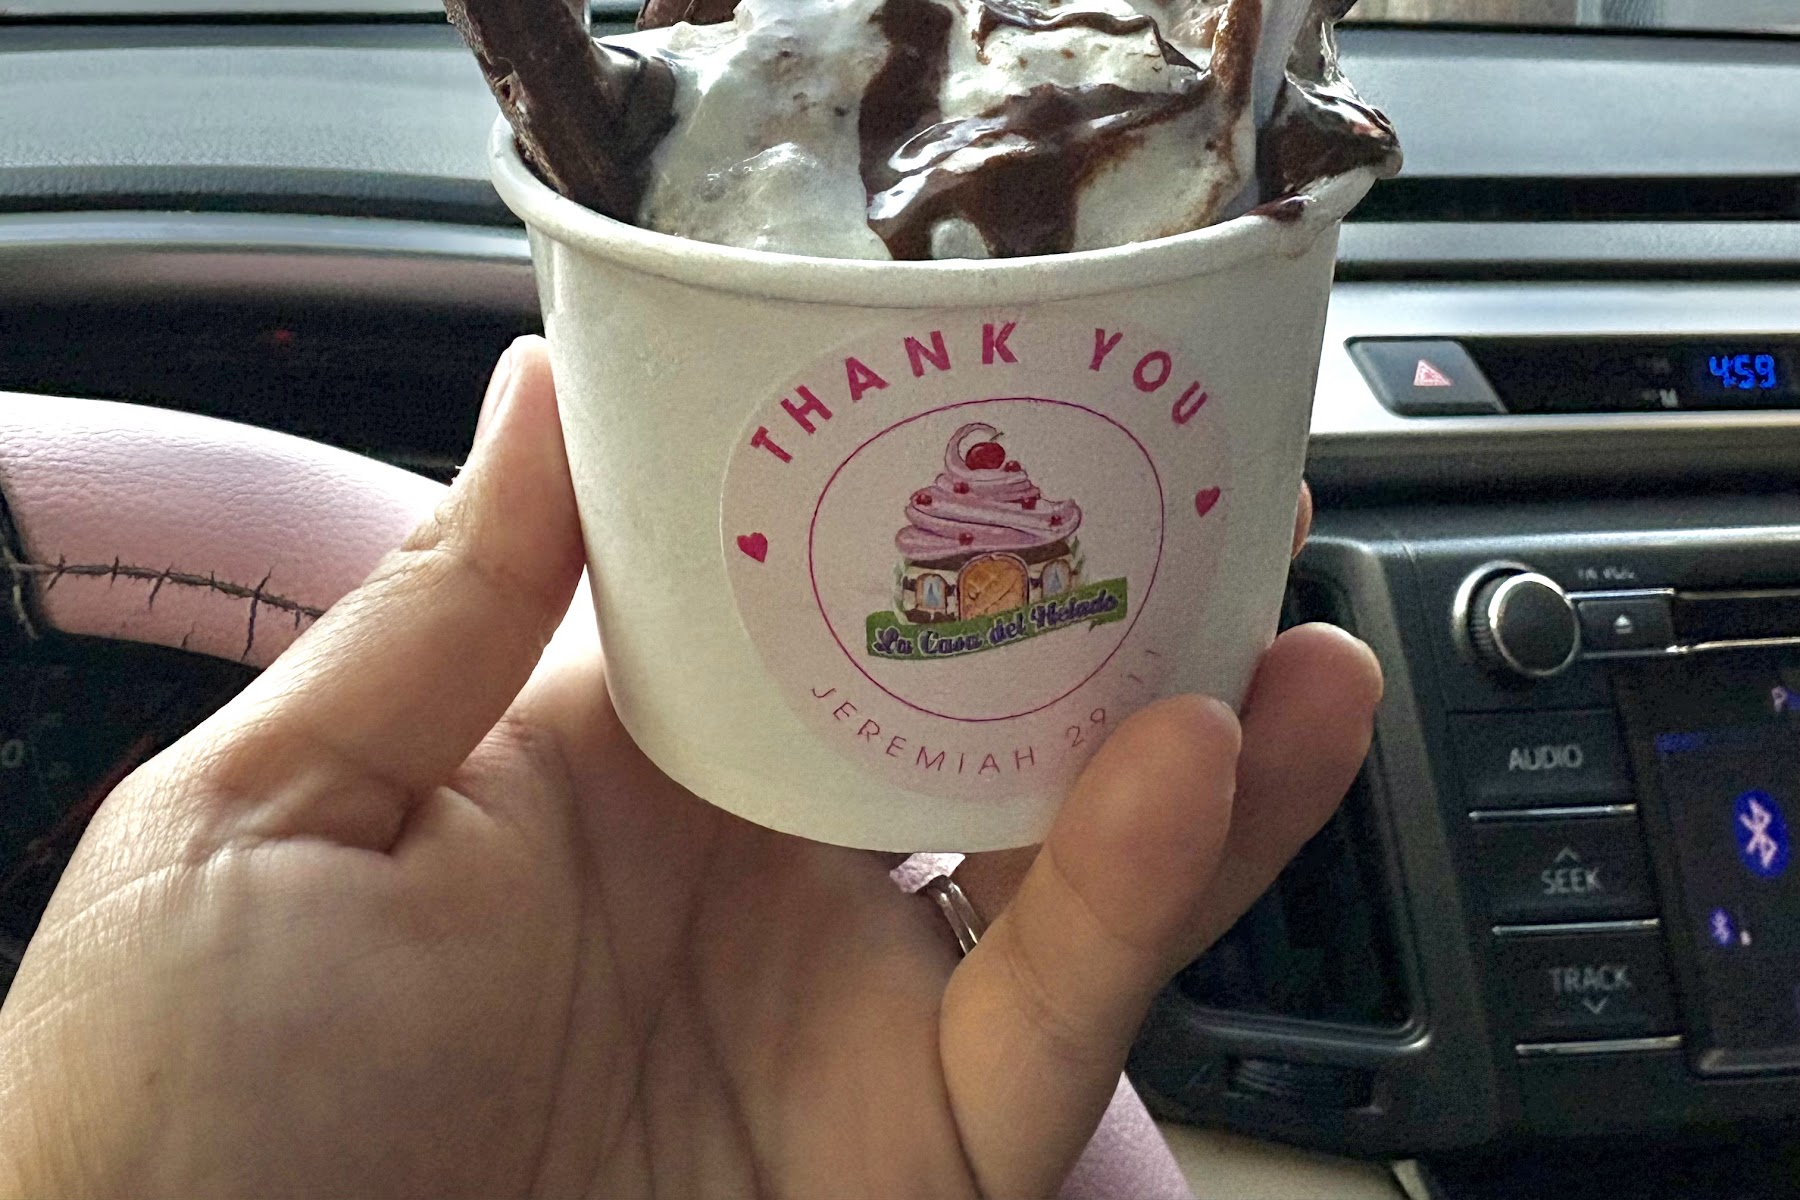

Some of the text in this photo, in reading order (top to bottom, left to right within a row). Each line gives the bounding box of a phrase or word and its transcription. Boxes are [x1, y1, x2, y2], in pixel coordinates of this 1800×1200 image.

[751, 321, 1208, 463] THANK YOU
[872, 626, 914, 656] La
[919, 629, 983, 657] Casa
[987, 611, 1026, 647] del
[810, 686, 1036, 774] JEREMIAH
[1508, 744, 1584, 771] AUDIO
[1541, 867, 1601, 894] SEEK
[1551, 965, 1633, 994] TRACK
